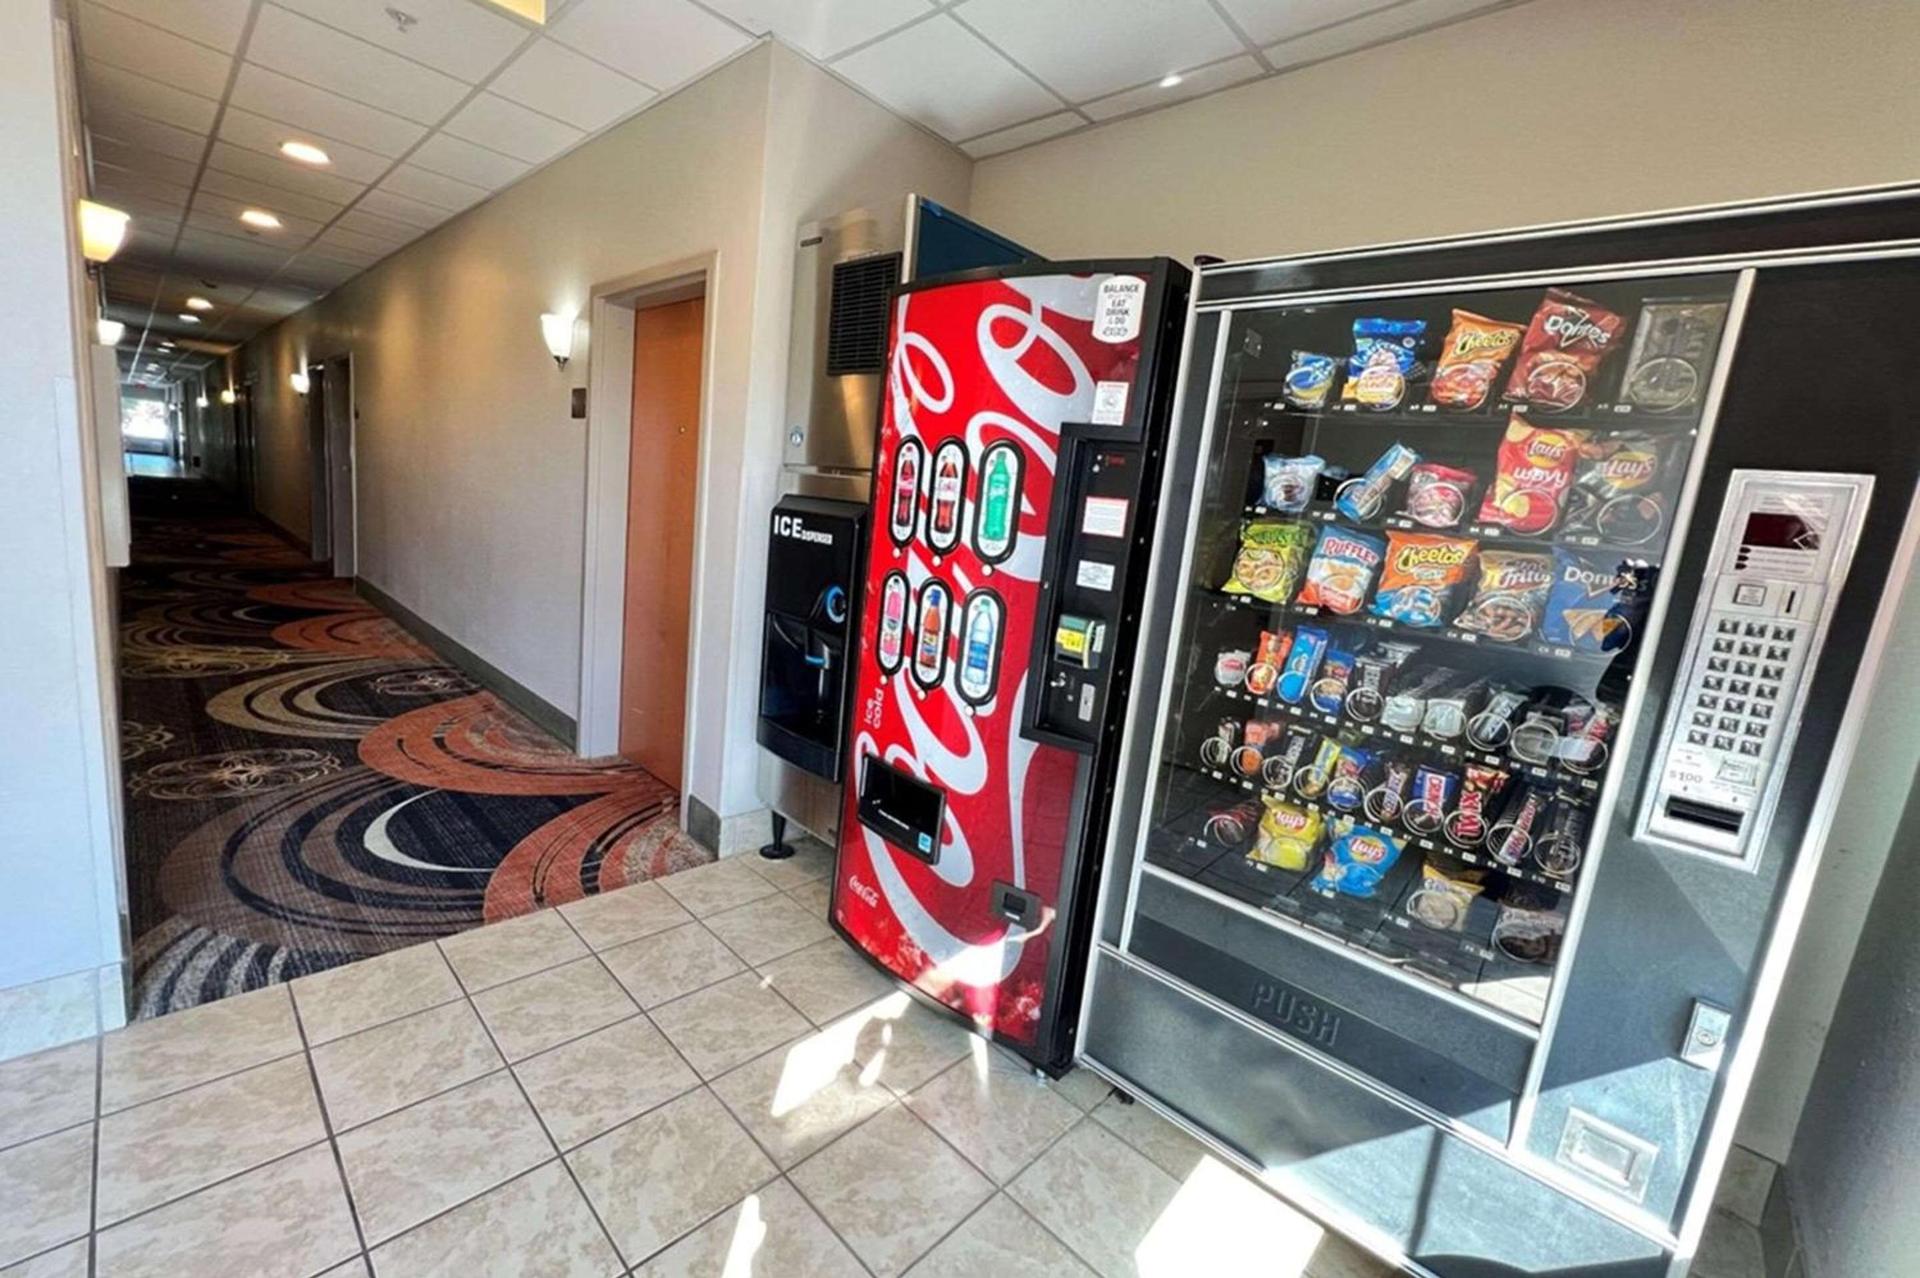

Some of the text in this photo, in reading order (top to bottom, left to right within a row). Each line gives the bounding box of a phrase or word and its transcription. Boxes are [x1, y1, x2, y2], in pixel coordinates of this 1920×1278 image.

[1103, 283, 1140, 294] BALANCE
[1453, 329, 1517, 355] Cheetos
[1543, 315, 1612, 345] Doritos
[773, 514, 803, 538] ICE
[1324, 537, 1380, 565] RUFFLES
[1397, 545, 1463, 570] Cheetos
[1456, 790, 1482, 837] TWIX
[1350, 837, 1386, 860] Lay's
[1250, 981, 1341, 1047] PUSH
